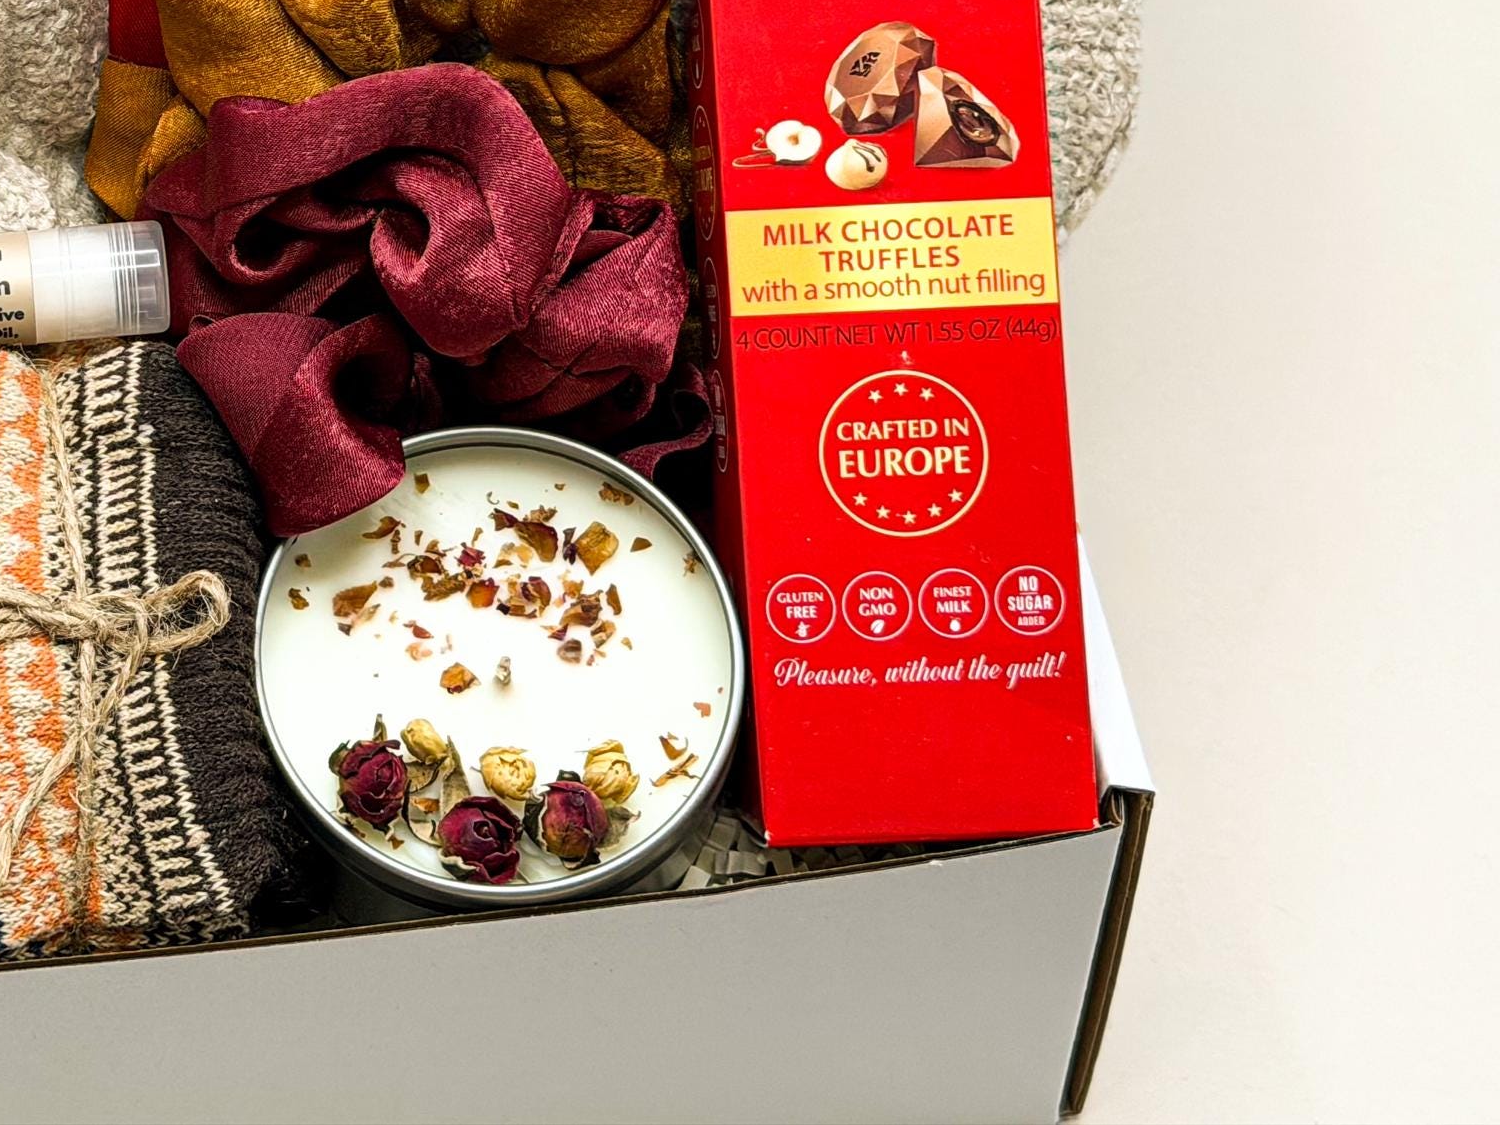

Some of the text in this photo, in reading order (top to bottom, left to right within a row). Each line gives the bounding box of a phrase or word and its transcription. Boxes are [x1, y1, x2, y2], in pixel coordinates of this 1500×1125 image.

[763, 214, 1015, 246] MILK CHOCOLATE
[819, 245, 961, 273] TRUFFLES
[742, 278, 798, 303] with
[804, 283, 818, 300] a
[824, 272, 922, 299] smooth
[928, 273, 971, 294] nut
[976, 268, 1046, 296] filling
[736, 331, 749, 350] 4
[754, 326, 832, 349] COUNT
[836, 325, 876, 345] NET
[885, 322, 919, 343] WT
[969, 319, 1000, 341] OZ
[1006, 316, 1058, 343] (44g)
[836, 418, 970, 443] CRAFTED IN
[838, 445, 972, 479] EUROPE
[1018, 575, 1038, 592] NO
[776, 591, 824, 605] GLUTEN
[859, 586, 894, 601] NON
[933, 586, 972, 599] FINEST
[858, 602, 897, 617] GMO
[936, 600, 972, 614] MILK
[1007, 594, 1053, 612] SUGAR
[785, 605, 818, 620] FREE
[1017, 615, 1045, 626] ADDED
[773, 651, 1067, 690] Pleasure, without the guilt!
